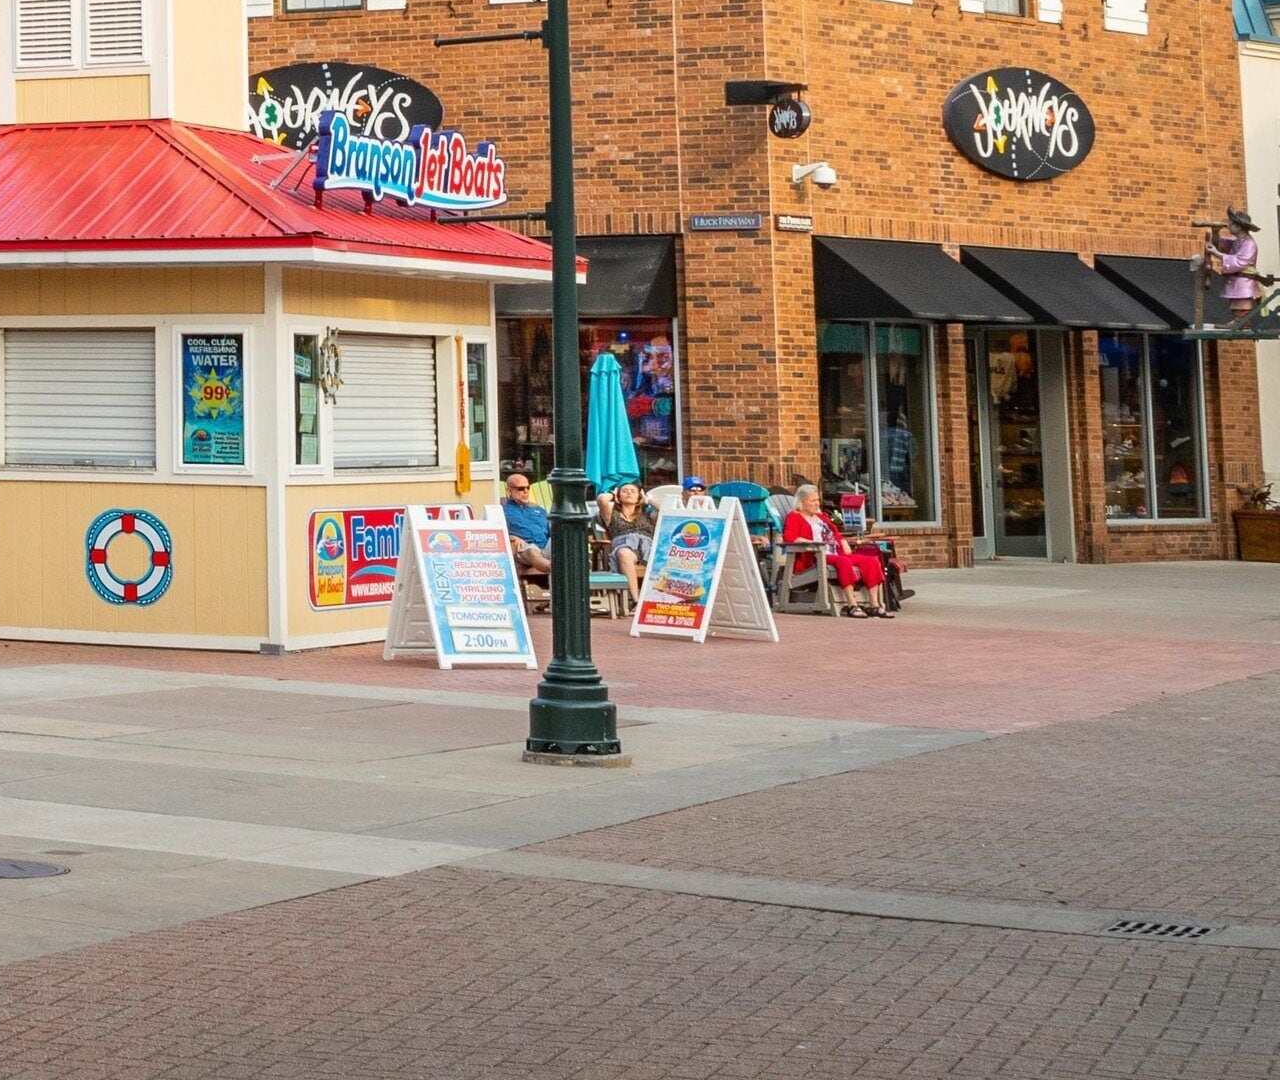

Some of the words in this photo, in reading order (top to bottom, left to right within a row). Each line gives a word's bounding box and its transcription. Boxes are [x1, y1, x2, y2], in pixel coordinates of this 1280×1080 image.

[970, 82, 1079, 158] JOURNEYS
[330, 116, 416, 201] Branson
[416, 131, 447, 199] Jet
[450, 137, 504, 199] Boats
[694, 217, 718, 226] HUCK
[719, 217, 737, 225] FINN
[738, 216, 756, 225] WAY
[187, 339, 210, 347] COOL,
[211, 339, 238, 347] CLEAR,
[191, 355, 238, 366] WATER
[203, 385, 231, 400] 99¢
[669, 546, 705, 561] Branson
[454, 561, 497, 569] RELAXING
[450, 570, 470, 578] LAKE
[470, 570, 505, 578] CRUISE
[433, 560, 452, 601] NEXT
[318, 579, 327, 597] Jet
[328, 578, 344, 594] Boats
[455, 585, 503, 594] THRILLING
[462, 594, 478, 602] JOY
[480, 594, 502, 602] RIDE
[450, 611, 507, 621] TOMORROW
